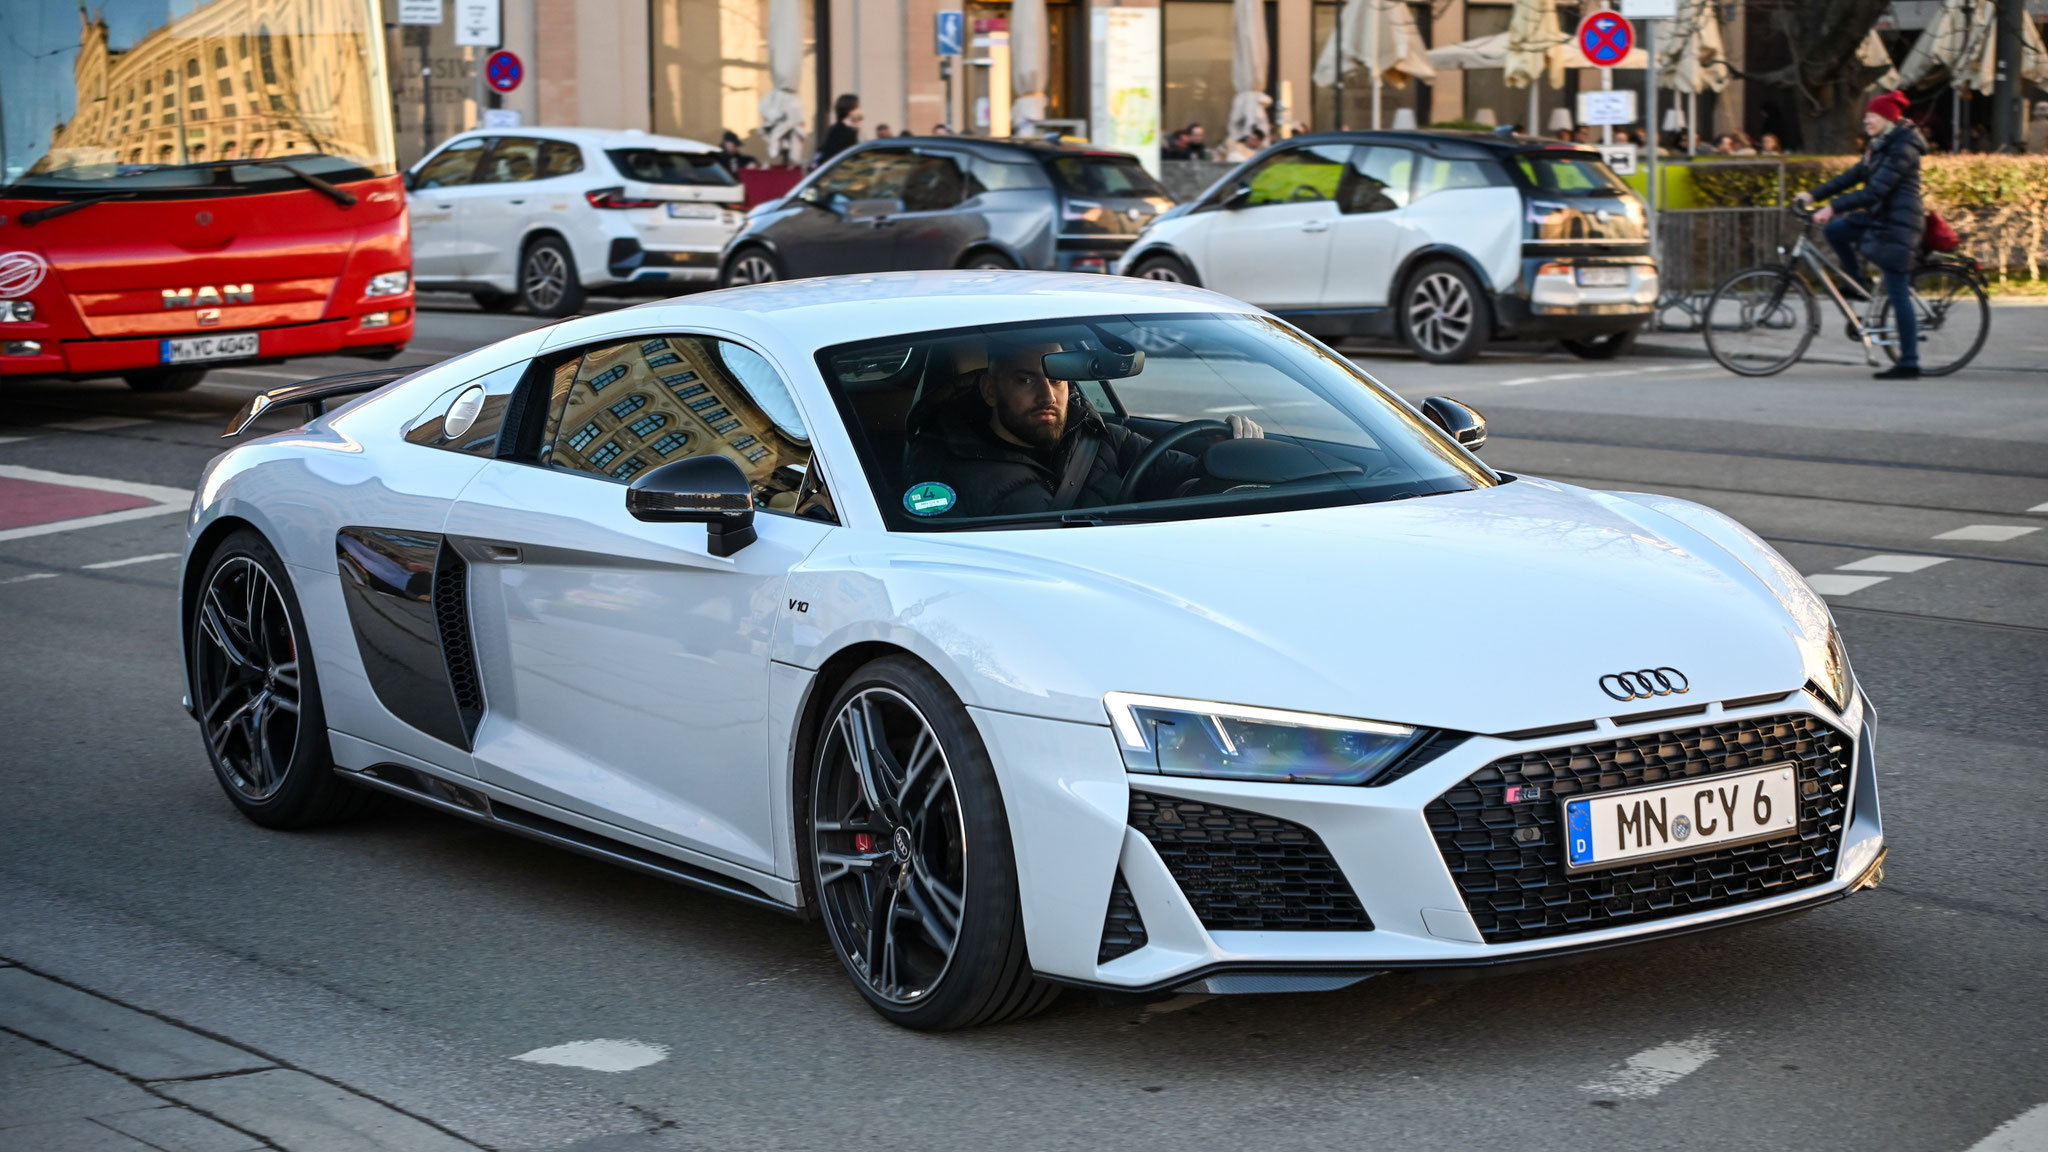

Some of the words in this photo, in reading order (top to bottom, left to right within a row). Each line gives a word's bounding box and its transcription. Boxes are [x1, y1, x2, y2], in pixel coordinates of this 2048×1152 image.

[162, 284, 254, 308] MAN
[923, 487, 936, 499] 4
[789, 599, 809, 613] V10
[1617, 797, 1668, 850] MN
[1694, 784, 1738, 836] CY
[1753, 779, 1772, 825] 6
[1576, 838, 1586, 853] D
